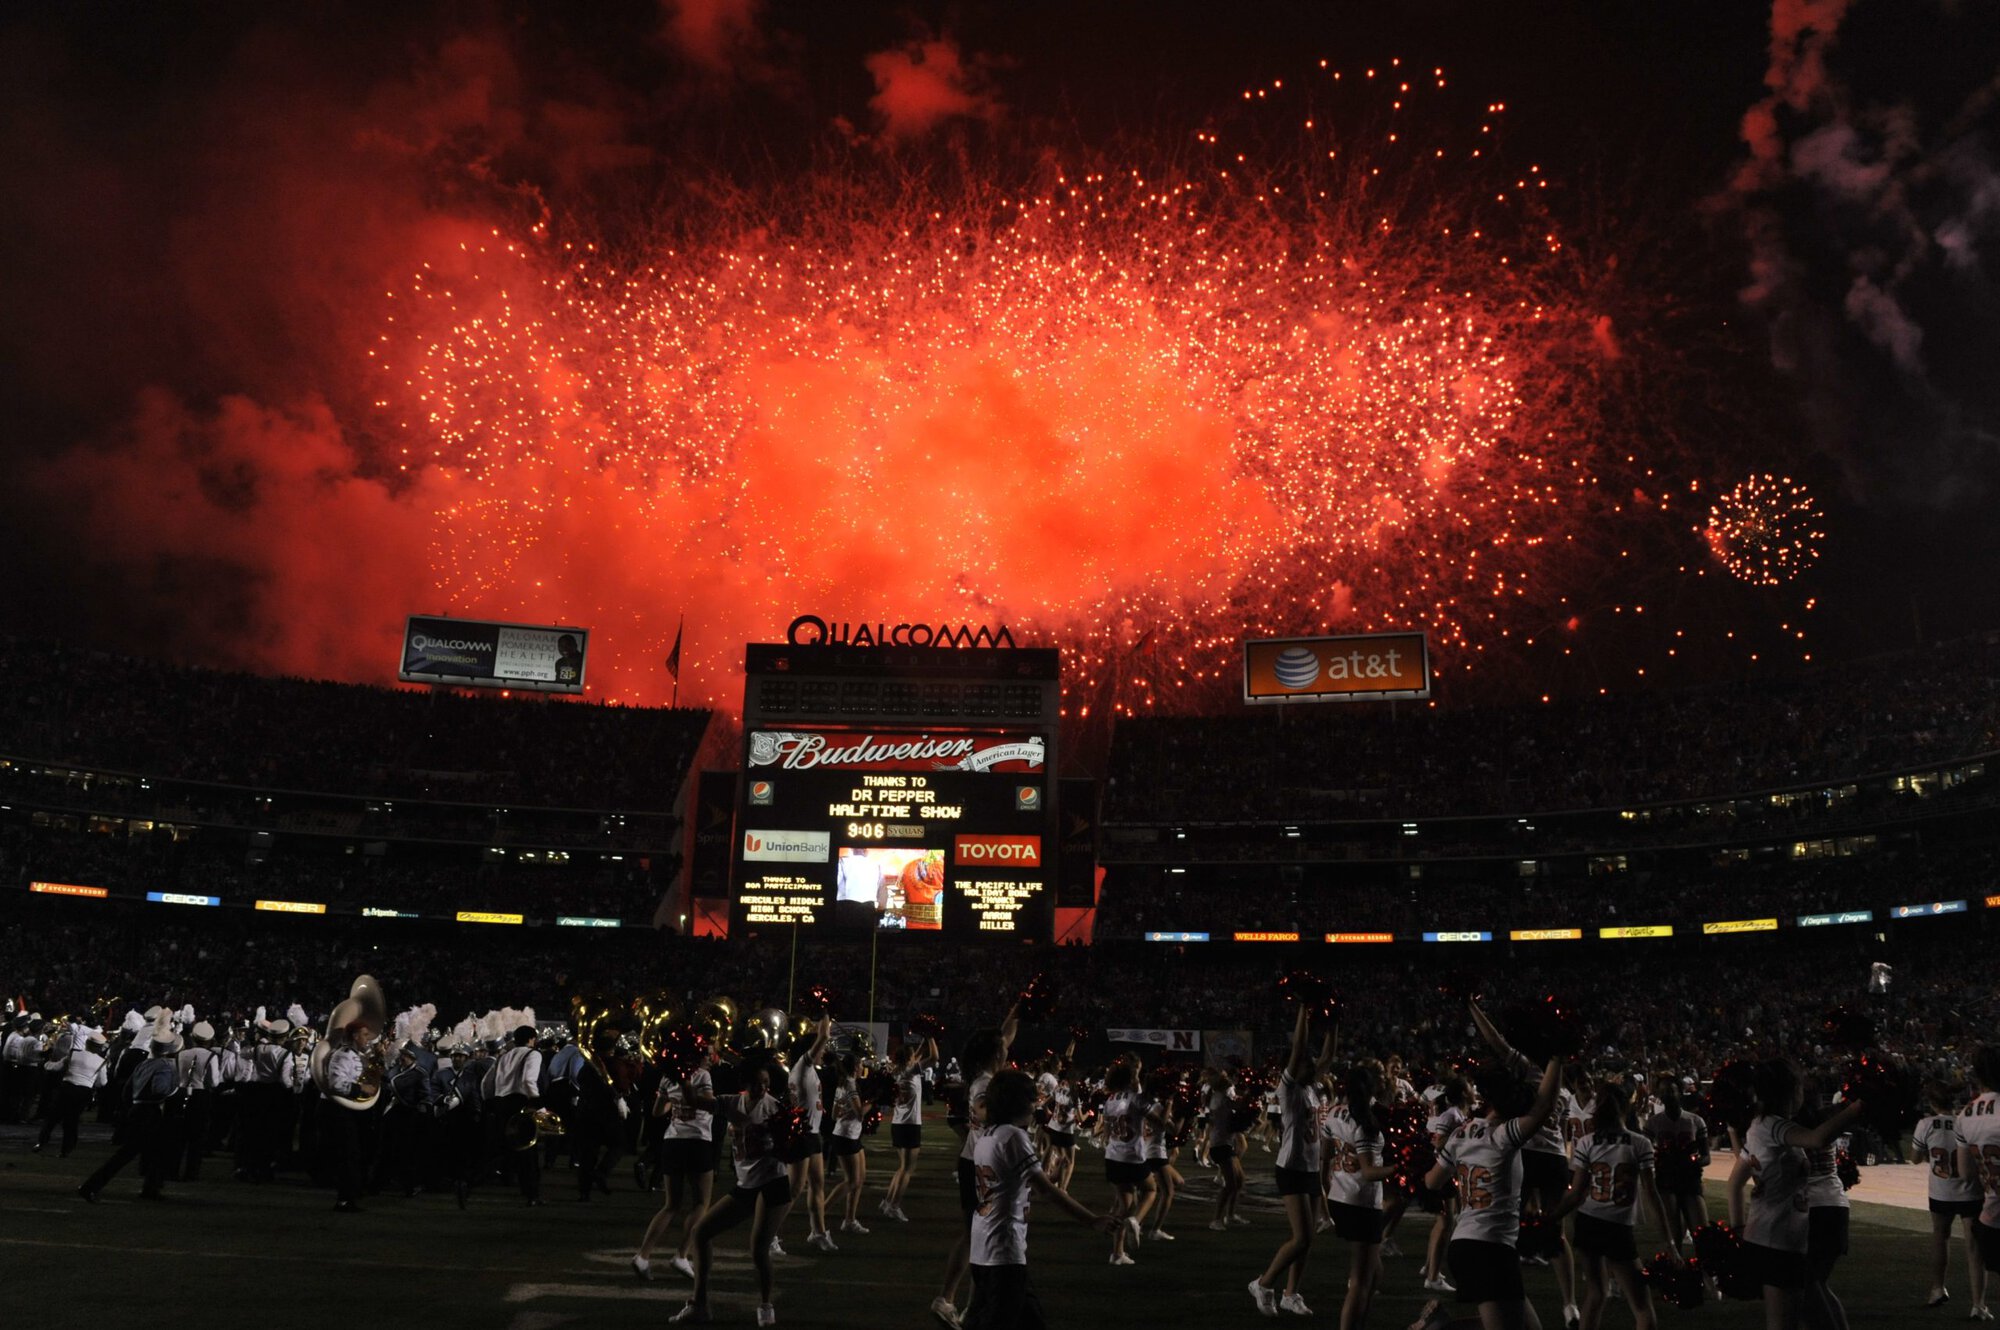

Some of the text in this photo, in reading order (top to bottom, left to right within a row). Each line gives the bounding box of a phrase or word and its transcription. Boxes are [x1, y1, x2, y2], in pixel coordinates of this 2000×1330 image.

[502, 631, 557, 643] PALOMAR
[787, 614, 1016, 648] QUALCOMM
[412, 635, 492, 652] QUALCOMM
[501, 640, 556, 652] POMERADO
[426, 652, 478, 664] innovation
[500, 650, 555, 661] HEALTH
[1328, 649, 1402, 680] at&t
[504, 669, 549, 679] www.pph.org
[776, 735, 974, 769] Budweiser
[976, 748, 1042, 766] American Lager
[863, 776, 926, 787] THANKS TO
[852, 789, 935, 803] DR PEPPER
[829, 804, 961, 819] HALFTIME SHOW
[848, 823, 884, 838] 9:06
[959, 844, 1037, 859] TOYOTA
[954, 881, 1043, 891] THE PACIFIC LIFE
[1007, 889, 1031, 897] BOWL
[740, 896, 824, 905] HERCULES MIDDLE
[263, 901, 320, 913] CYMER
[750, 905, 813, 914] HIGH SCHOOL
[802, 915, 815, 923] CA
[979, 921, 1015, 930] MILLER
[1235, 932, 1299, 941] WELLS FARGO
[1437, 932, 1480, 942] GEICO
[1520, 930, 1572, 940] CYMER
[1173, 1031, 1193, 1049] N
